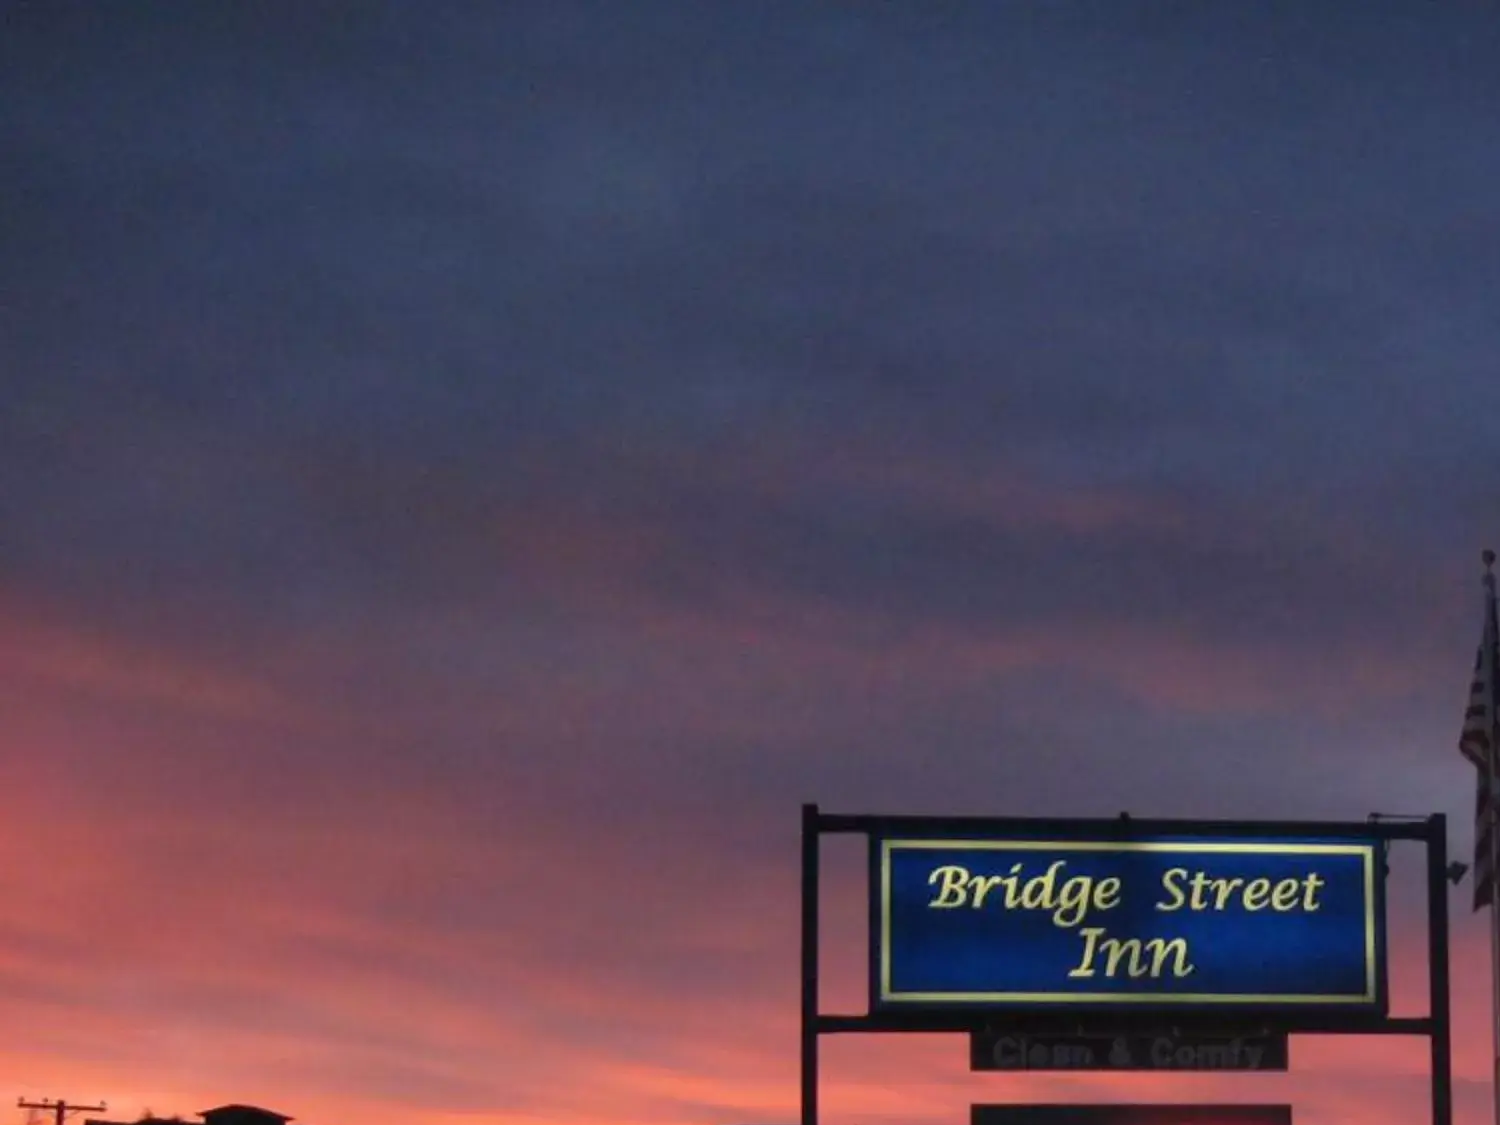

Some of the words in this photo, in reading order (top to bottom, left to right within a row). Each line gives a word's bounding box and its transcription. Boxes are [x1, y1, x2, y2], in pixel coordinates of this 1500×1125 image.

[928, 860, 1121, 928] Bridge
[1155, 867, 1324, 912] Street
[1067, 927, 1194, 977] Inn
[993, 1036, 1095, 1067] Clean
[1108, 1036, 1131, 1066] &
[1152, 1036, 1264, 1069] Comfy
